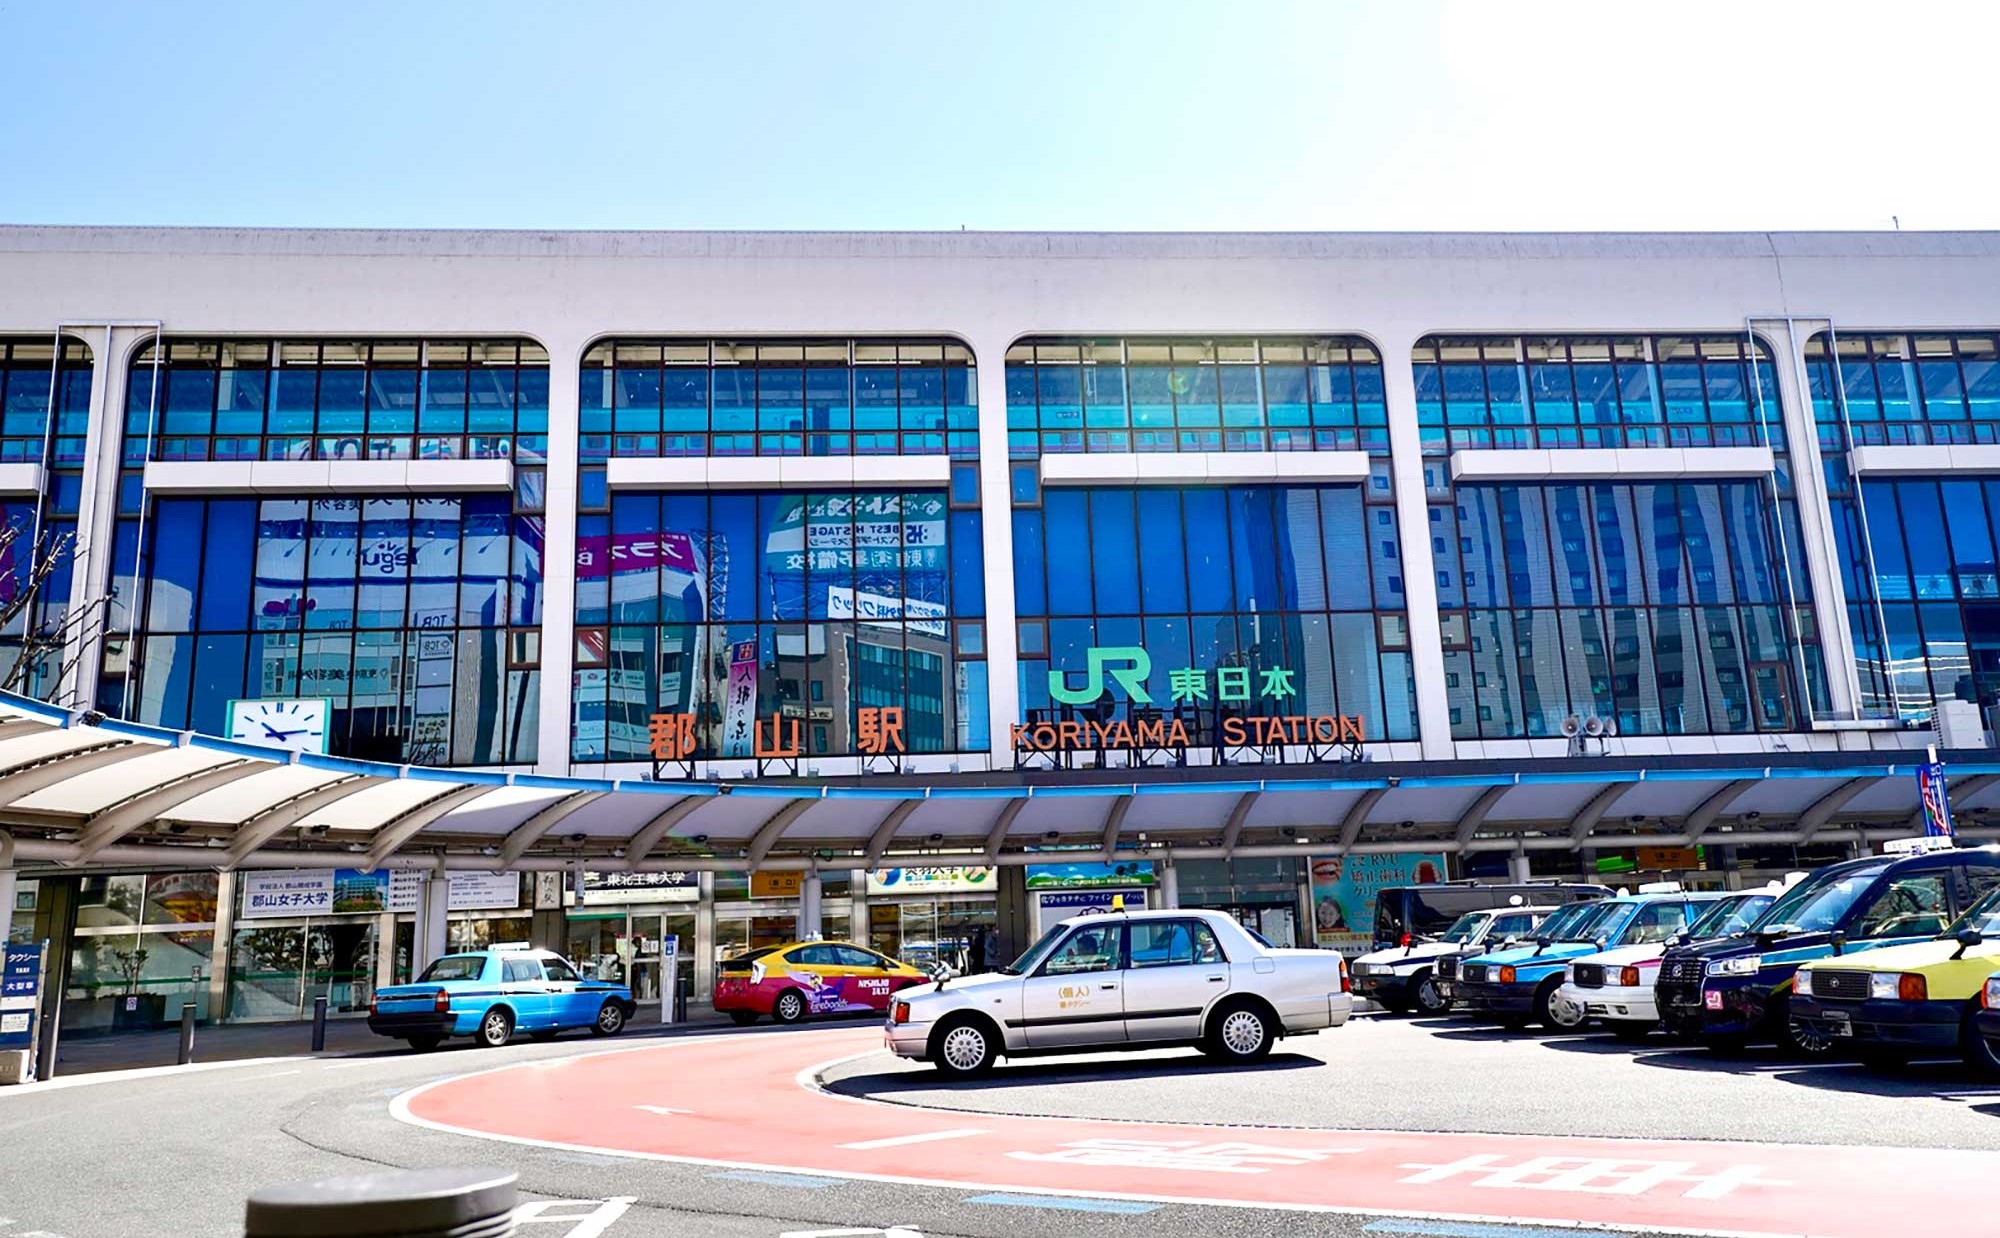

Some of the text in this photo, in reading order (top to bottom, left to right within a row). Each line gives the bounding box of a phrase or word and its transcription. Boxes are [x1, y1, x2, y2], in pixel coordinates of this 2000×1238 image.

[1048, 646, 1153, 704] JR
[1169, 665, 1296, 702] 東日本
[648, 707, 905, 759] 郡山駅
[1223, 714, 1365, 746] STATION
[606, 872, 686, 887] 東北工業大学
[251, 892, 329, 907] 郡山女子大学
[8, 953, 40, 963] タクシー
[6, 981, 35, 991] 大型車
[871, 987, 890, 996] TAXI
